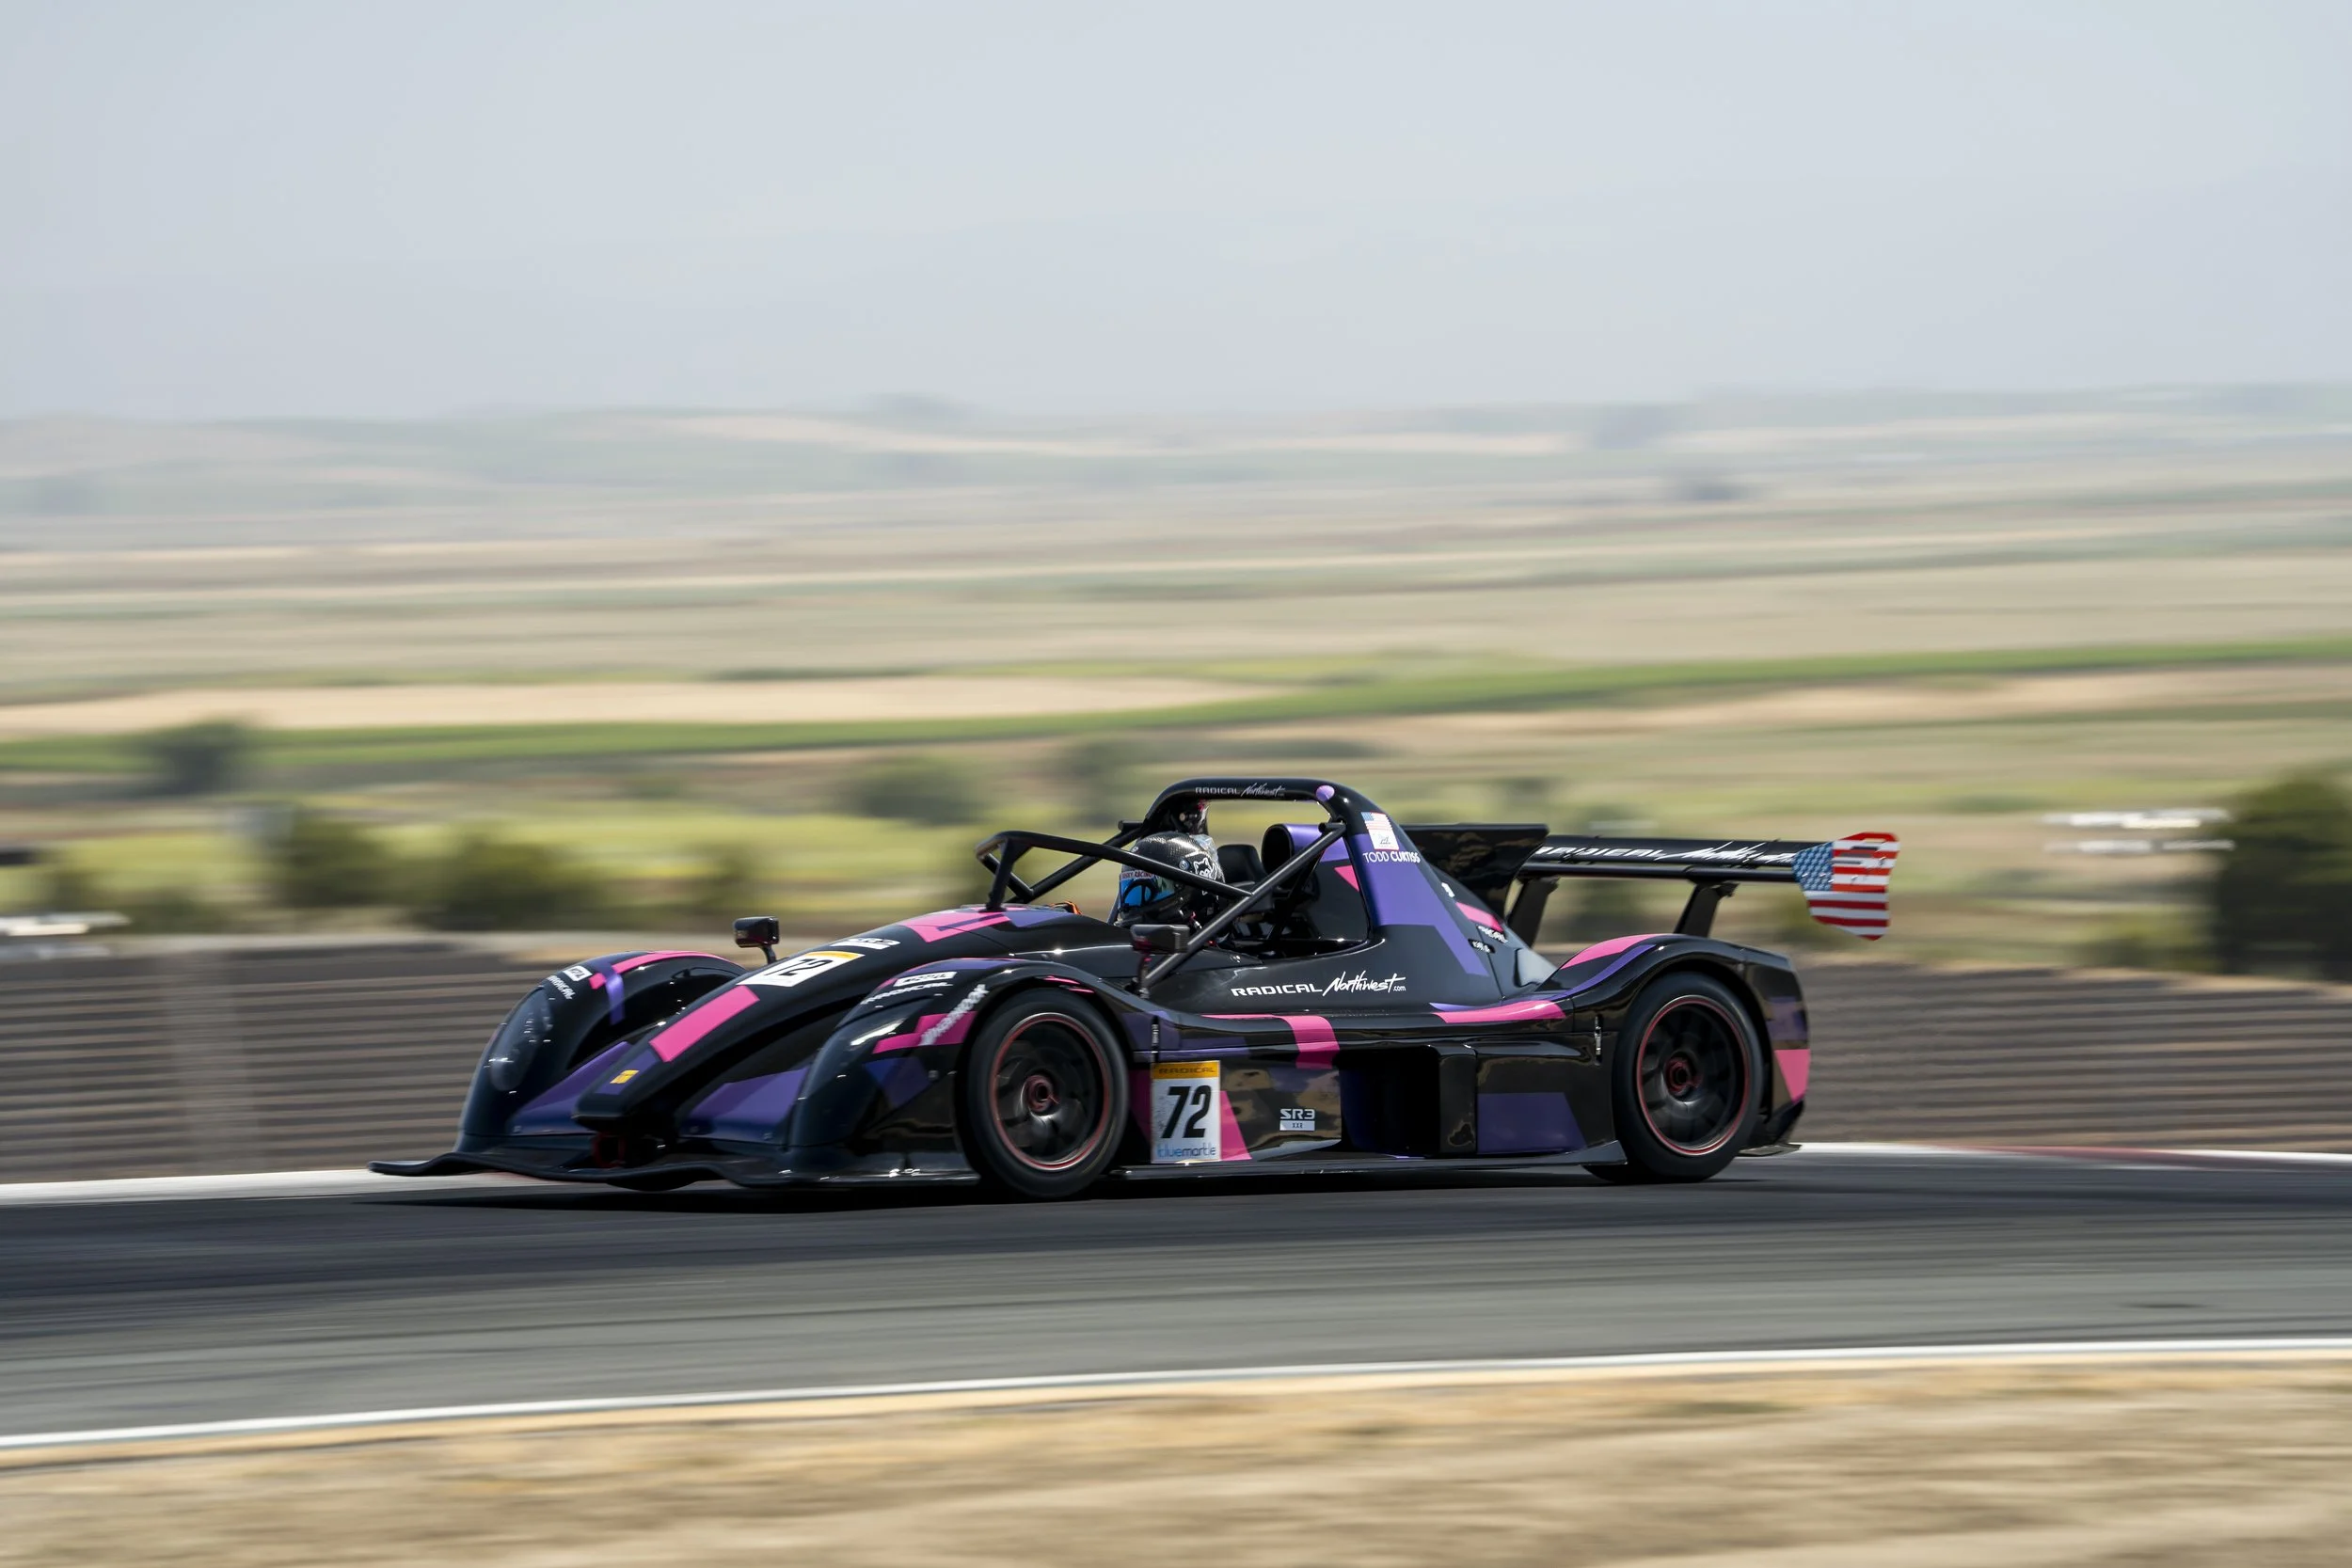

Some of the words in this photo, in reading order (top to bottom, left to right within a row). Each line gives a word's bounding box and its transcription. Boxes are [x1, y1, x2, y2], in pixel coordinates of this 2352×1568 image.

[1195, 786, 1240, 795] RADICAL
[1363, 851, 1390, 863] TODD
[1390, 851, 1421, 863] CURTISS
[764, 958, 834, 976] 72
[1231, 983, 1323, 997] RADICAL
[1160, 1085, 1212, 1139] 72
[1279, 1108, 1315, 1119] SR3
